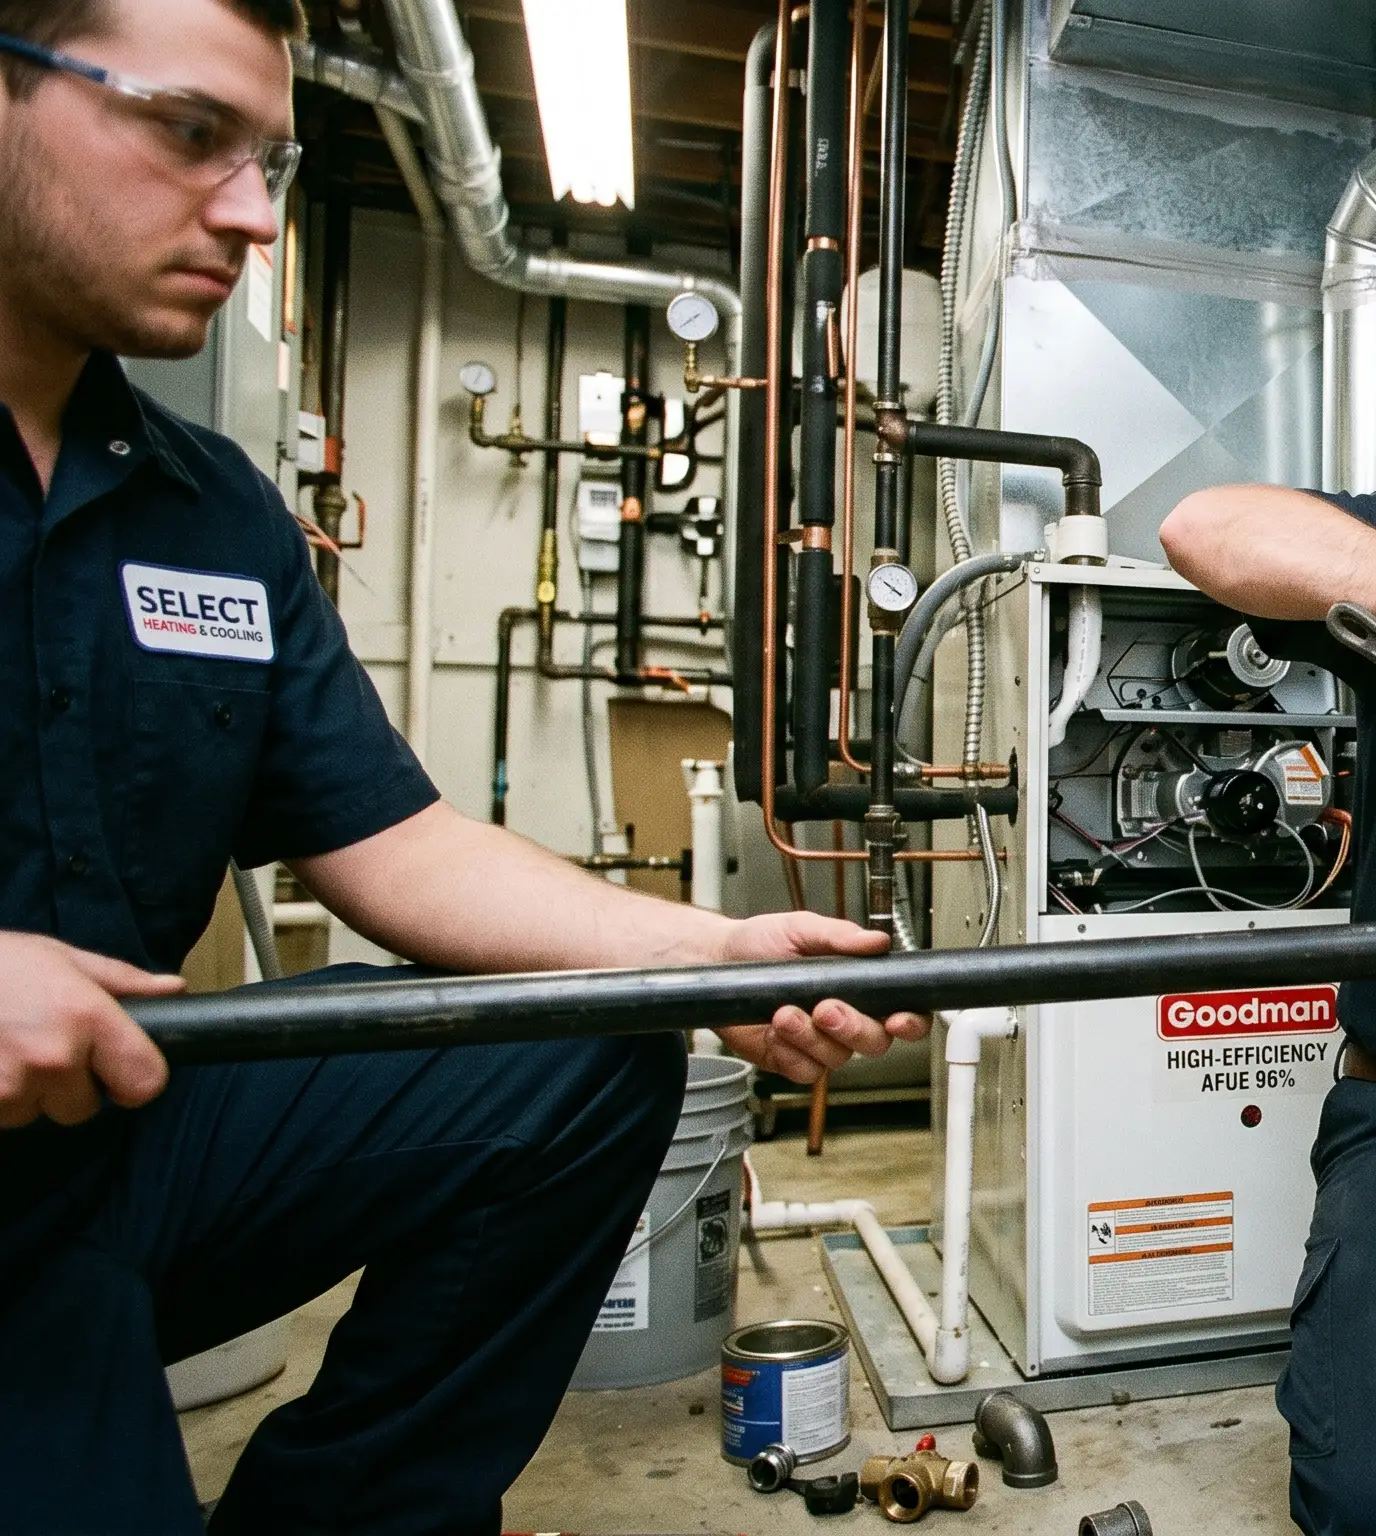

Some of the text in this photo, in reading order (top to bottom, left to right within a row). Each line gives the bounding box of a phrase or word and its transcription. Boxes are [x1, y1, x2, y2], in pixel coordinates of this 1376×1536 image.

[136, 585, 259, 626] SELECT
[142, 617, 263, 643] HEATING & COOLING
[1167, 997, 1330, 1029] Goodman
[1167, 1042, 1328, 1070] HIGH-EFFICIENCY
[1201, 1069, 1296, 1092] AFUE 96%
